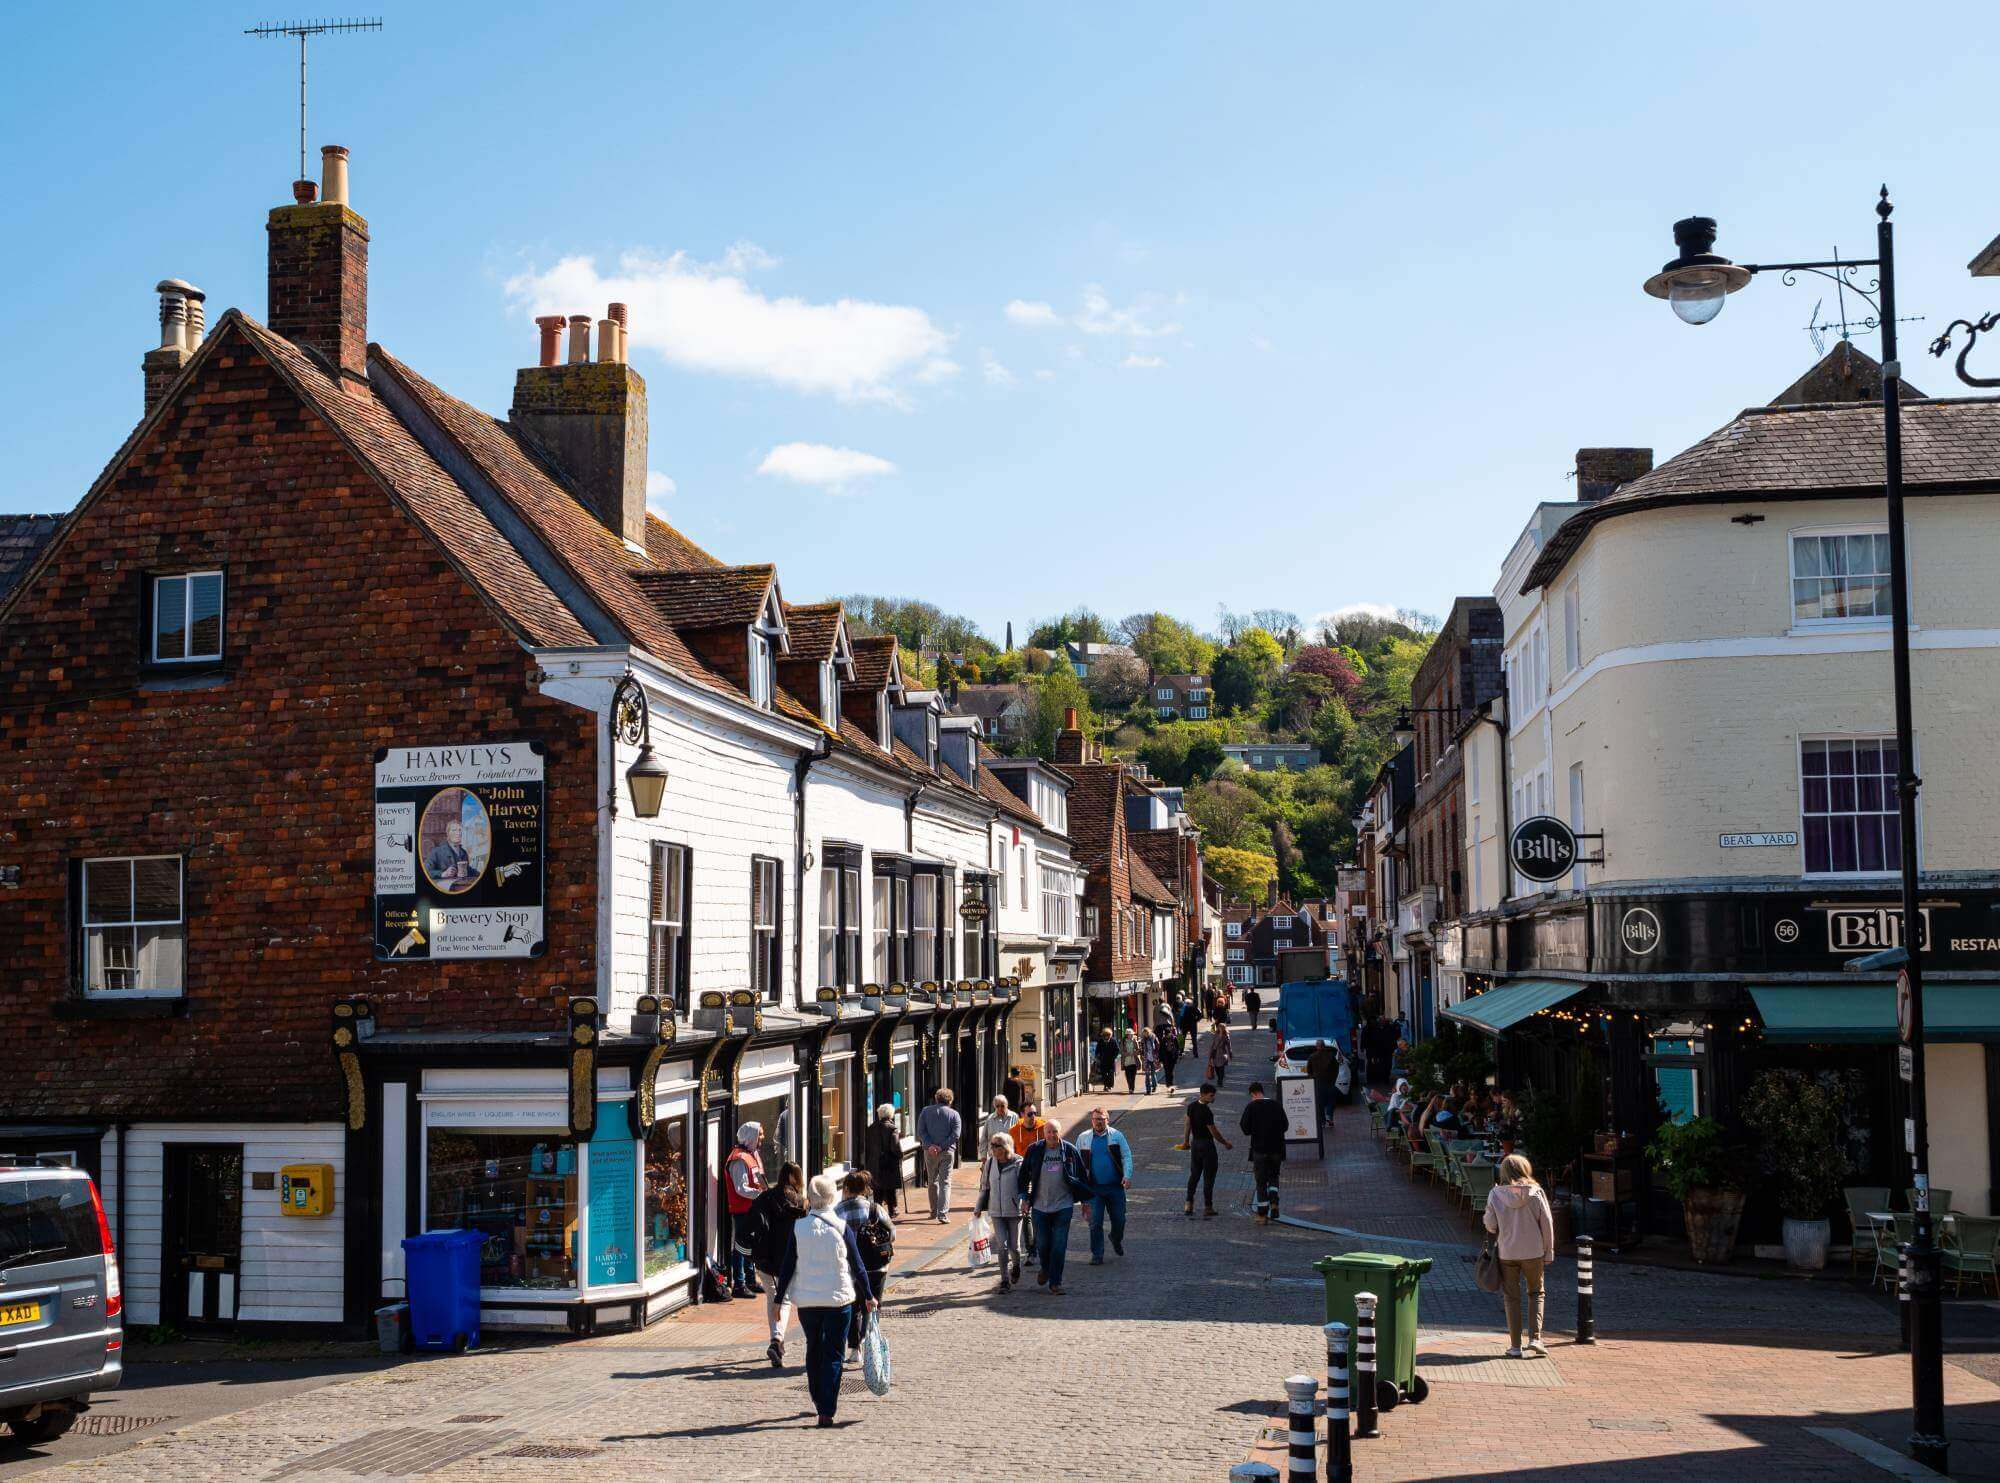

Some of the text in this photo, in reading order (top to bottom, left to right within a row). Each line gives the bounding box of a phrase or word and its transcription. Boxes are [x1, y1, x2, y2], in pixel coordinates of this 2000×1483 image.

[381, 768, 537, 783] The Sussex Brewers Founded 1790
[490, 786, 525, 800] John
[378, 807, 411, 816] Brewery
[490, 804, 539, 818] Harvey
[378, 818, 396, 826] Yard
[504, 820, 537, 829] Tavern
[1723, 834, 1794, 845] BEAR YARD
[1517, 834, 1570, 862] Bill's
[385, 910, 408, 918] Offices
[437, 910, 529, 927] Brewery Shop
[1625, 921, 1656, 940] Bill's
[1779, 925, 1794, 936] 56
[450, 935, 476, 943] Licence
[1951, 938, 2000, 951] RESTA
[472, 944, 506, 952] Merchants
[5, 1305, 32, 1321] XAD
